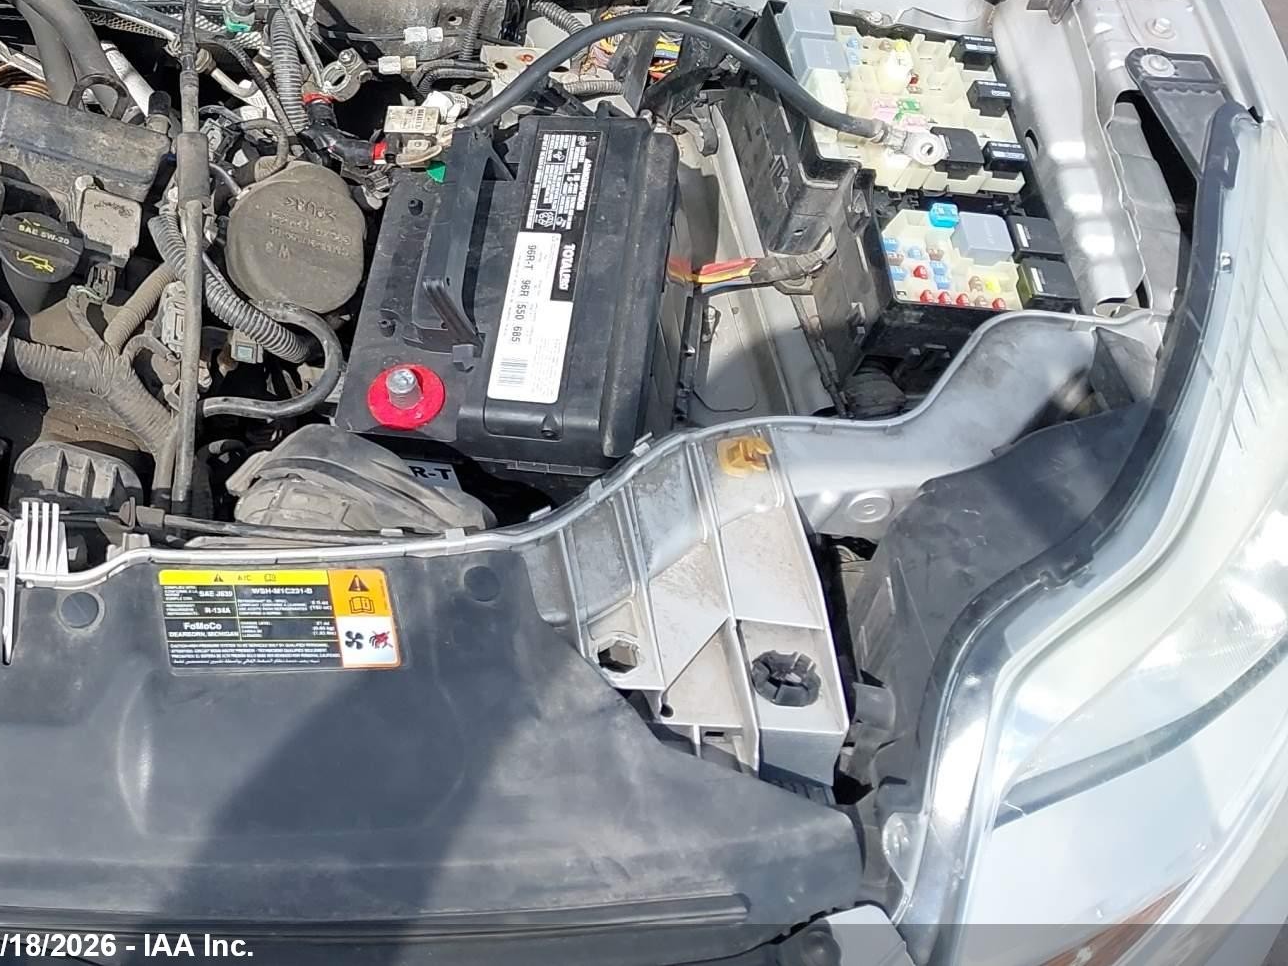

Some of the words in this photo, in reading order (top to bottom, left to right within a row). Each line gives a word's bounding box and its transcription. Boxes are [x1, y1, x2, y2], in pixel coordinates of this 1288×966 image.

[18, 224, 39, 236] SAE
[40, 230, 70, 245] 5W-20
[524, 244, 537, 271] 96R-T
[520, 279, 531, 297] 96R
[515, 304, 527, 321] 550
[183, 622, 222, 630] FoMoCo
